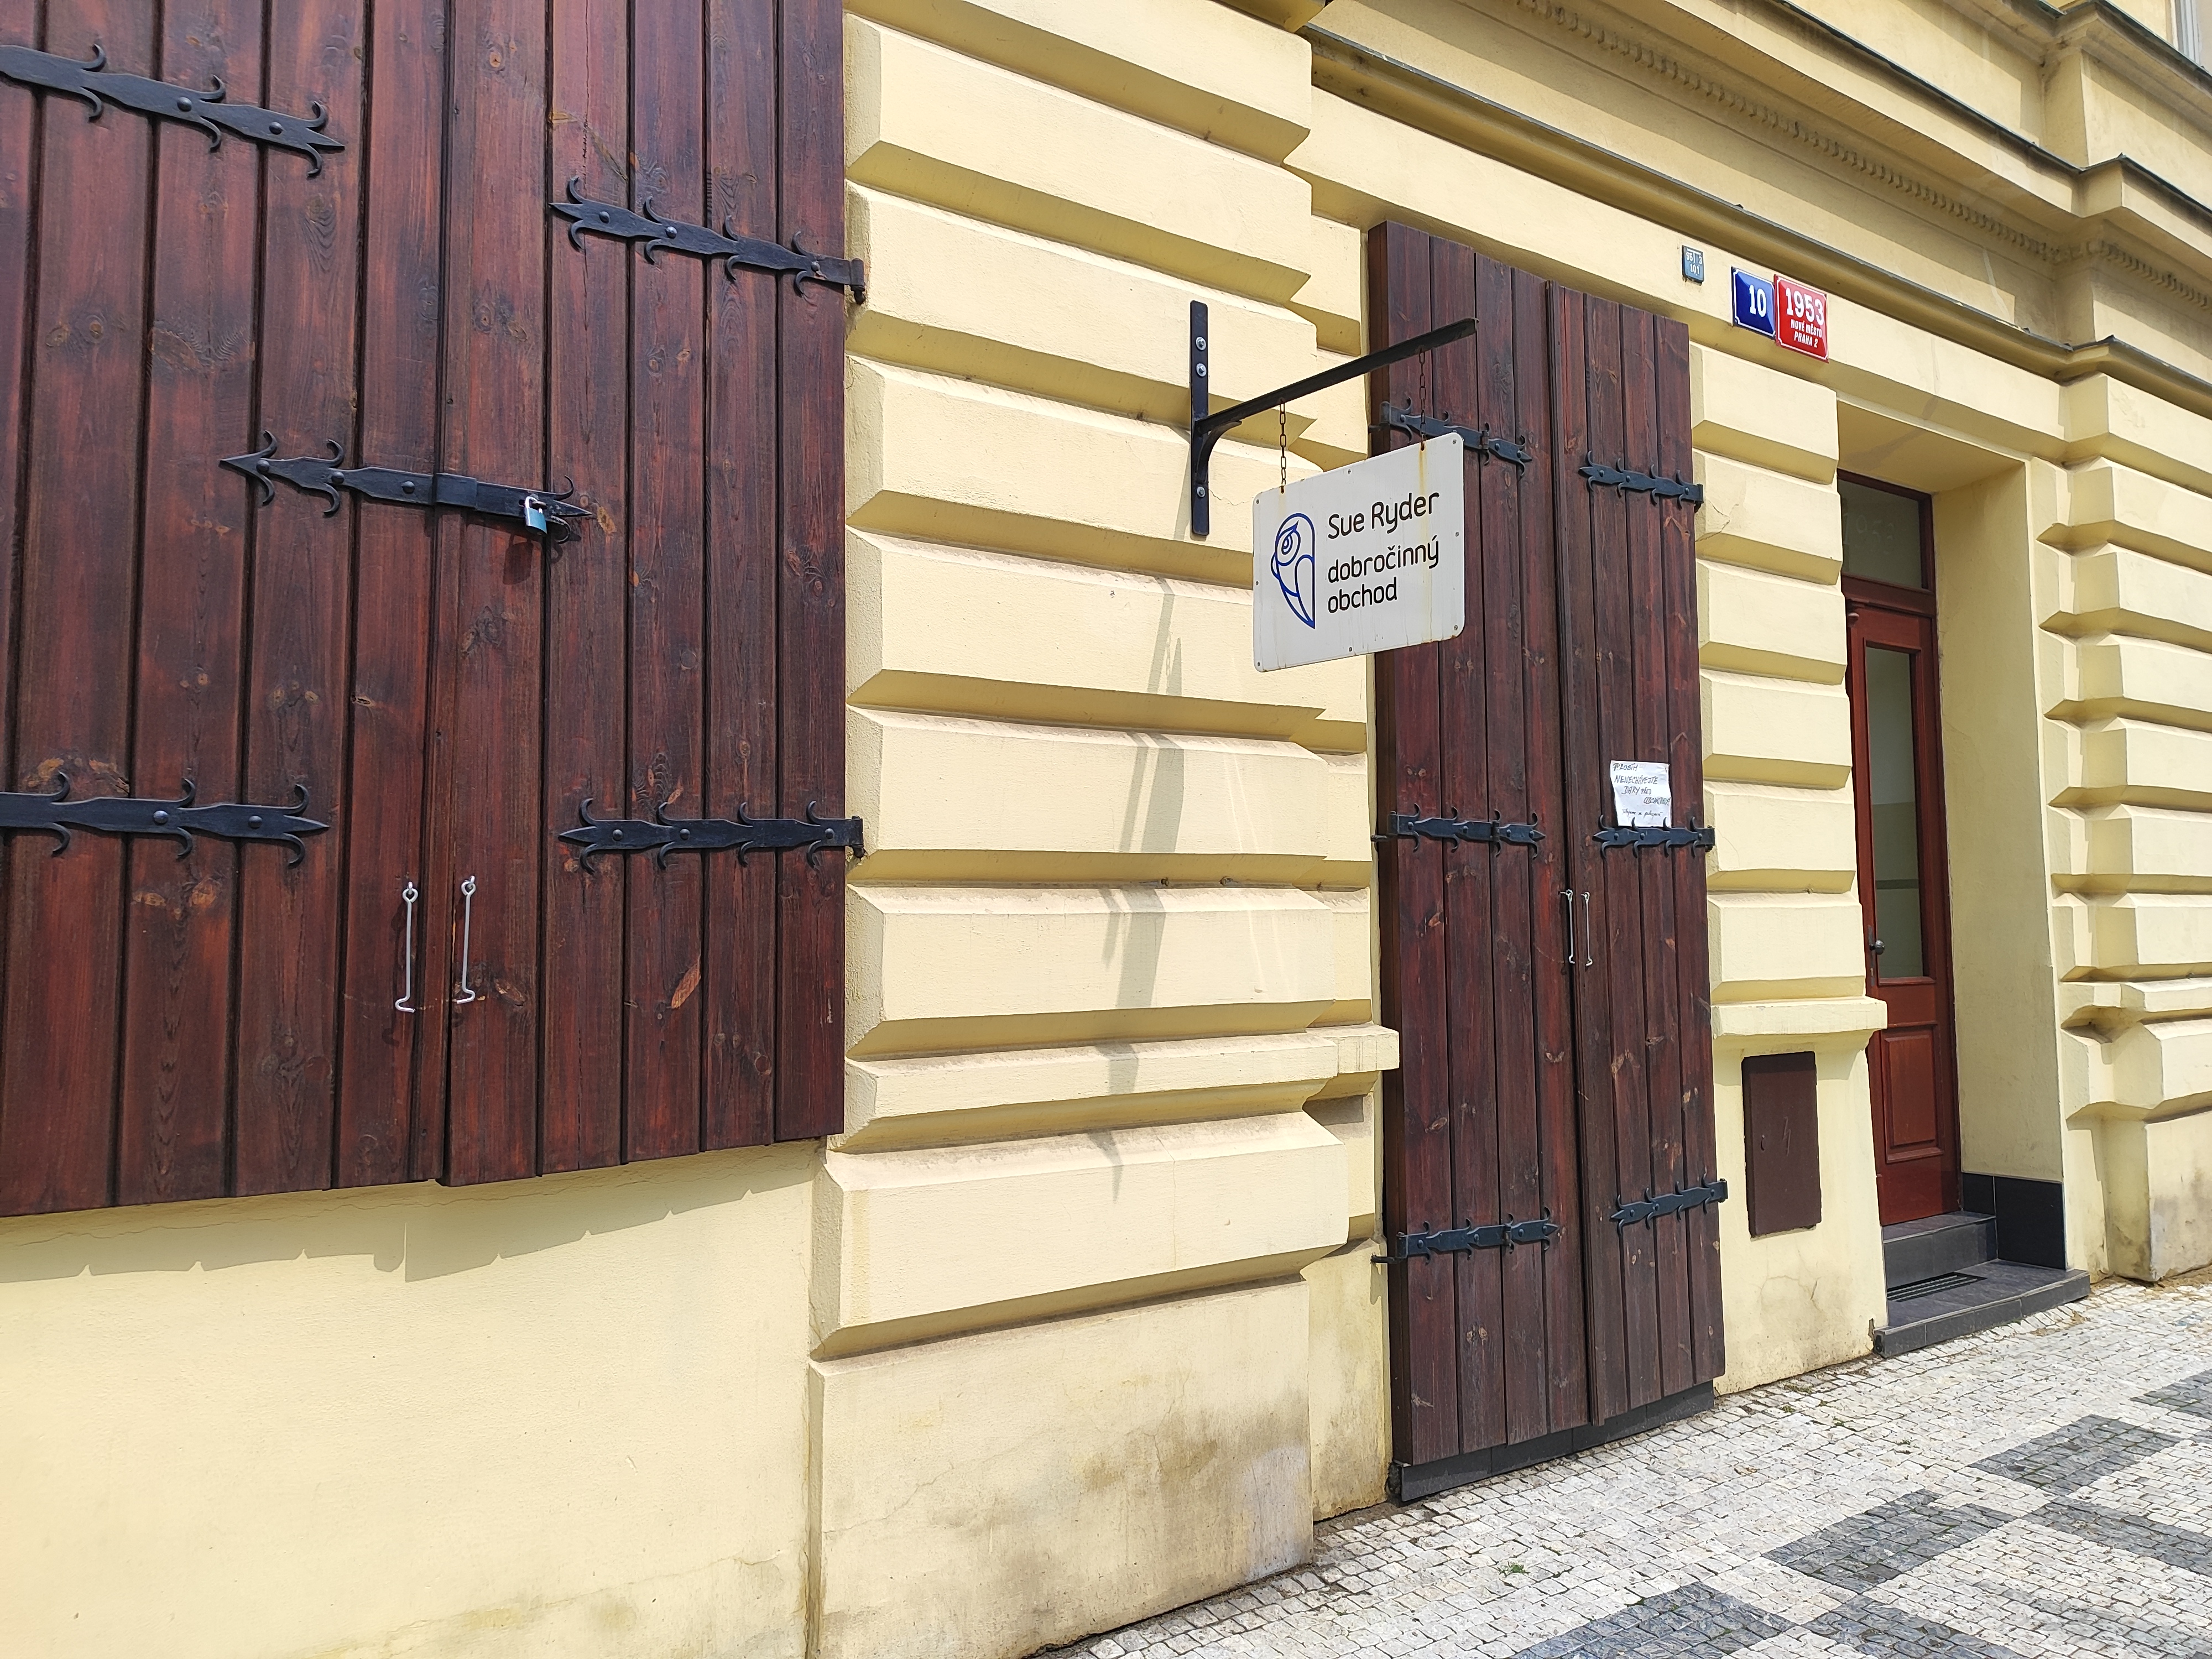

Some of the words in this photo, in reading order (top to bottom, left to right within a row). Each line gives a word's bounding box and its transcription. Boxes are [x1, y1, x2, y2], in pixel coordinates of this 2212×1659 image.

[1749, 284, 1766, 317] 10
[1786, 287, 1824, 326] 1953
[1791, 319, 1805, 332] NOVÉ
[1806, 323, 1822, 338] MĚSTO
[1793, 331, 1813, 346] PRAHA
[1814, 338, 1818, 348] 2
[1328, 513, 1364, 539] Sue
[1371, 492, 1439, 534] Ryder
[1328, 534, 1439, 583] dobročinný
[1328, 576, 1397, 613] obchod
